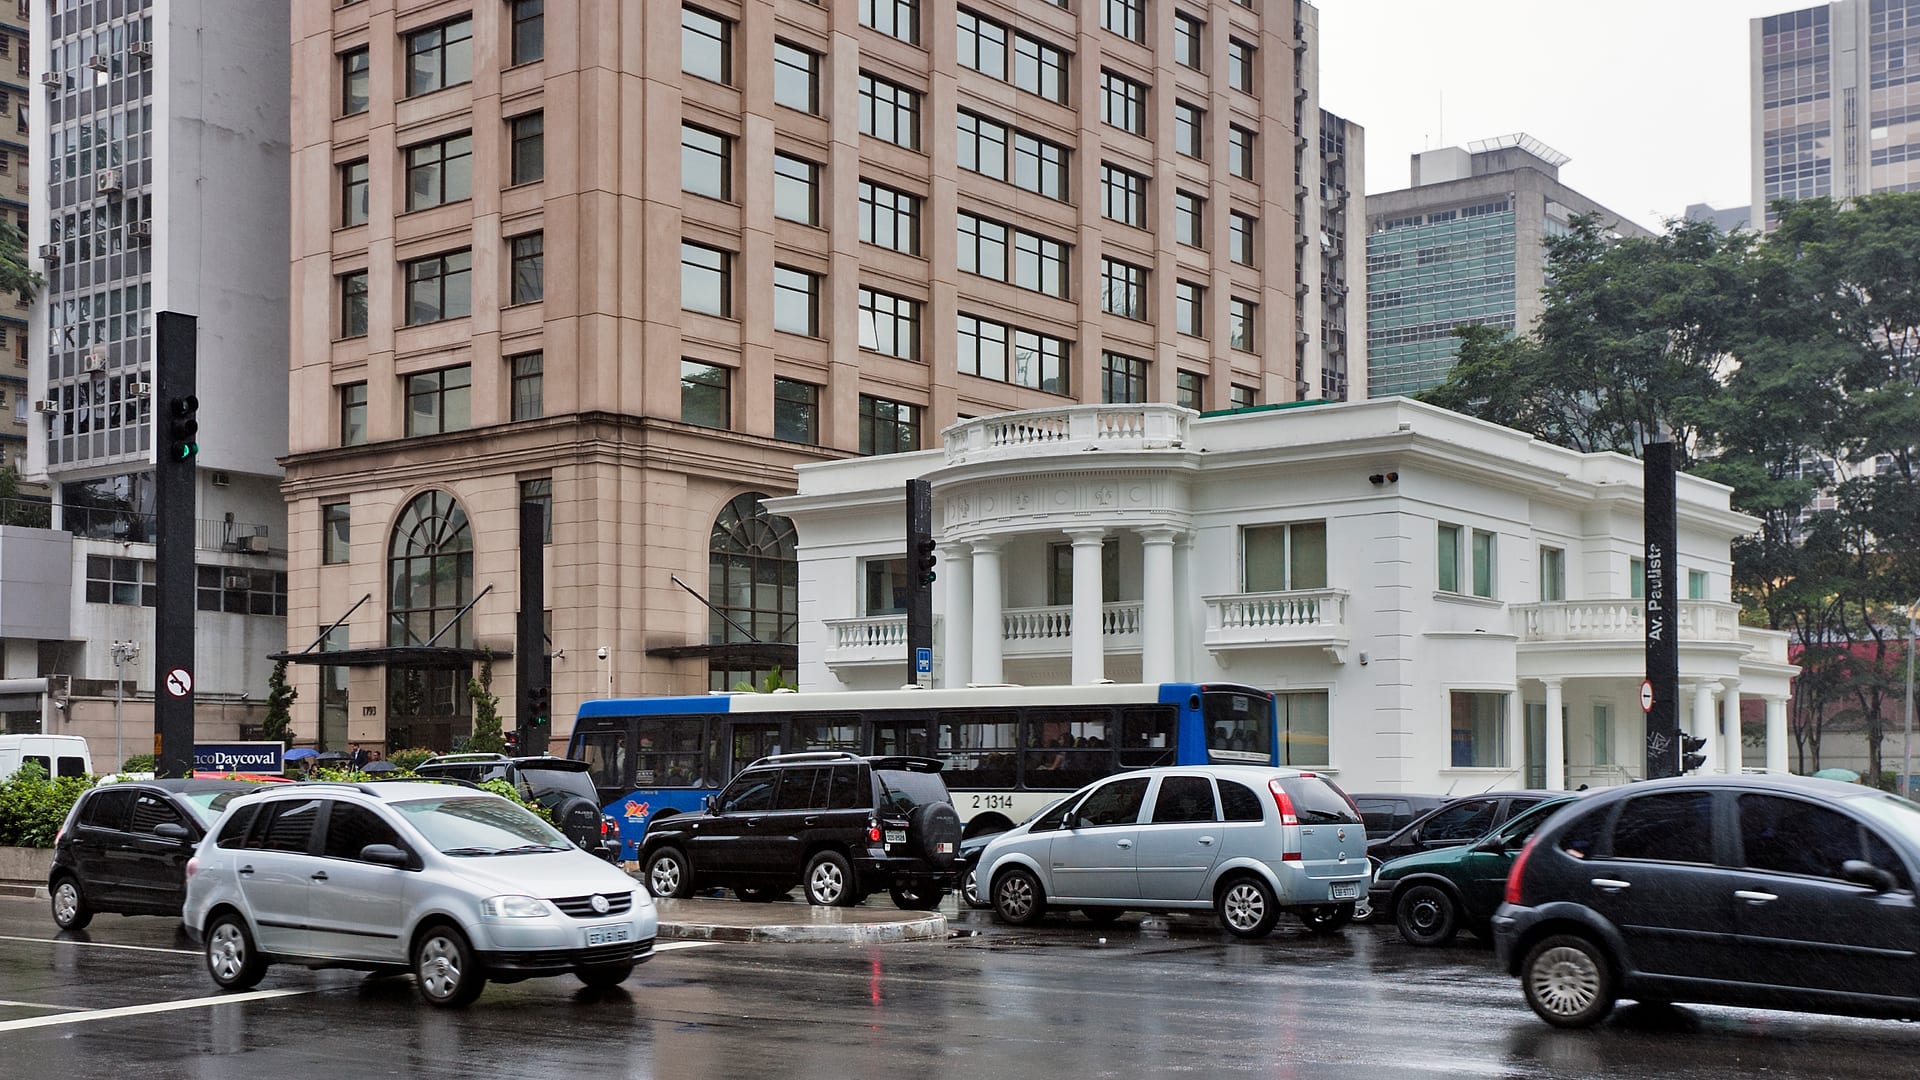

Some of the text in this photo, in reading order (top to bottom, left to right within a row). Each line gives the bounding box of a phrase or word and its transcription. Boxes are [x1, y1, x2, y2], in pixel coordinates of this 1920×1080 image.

[1648, 615, 1663, 641] Av.
[972, 794, 1013, 809] 2 1314
